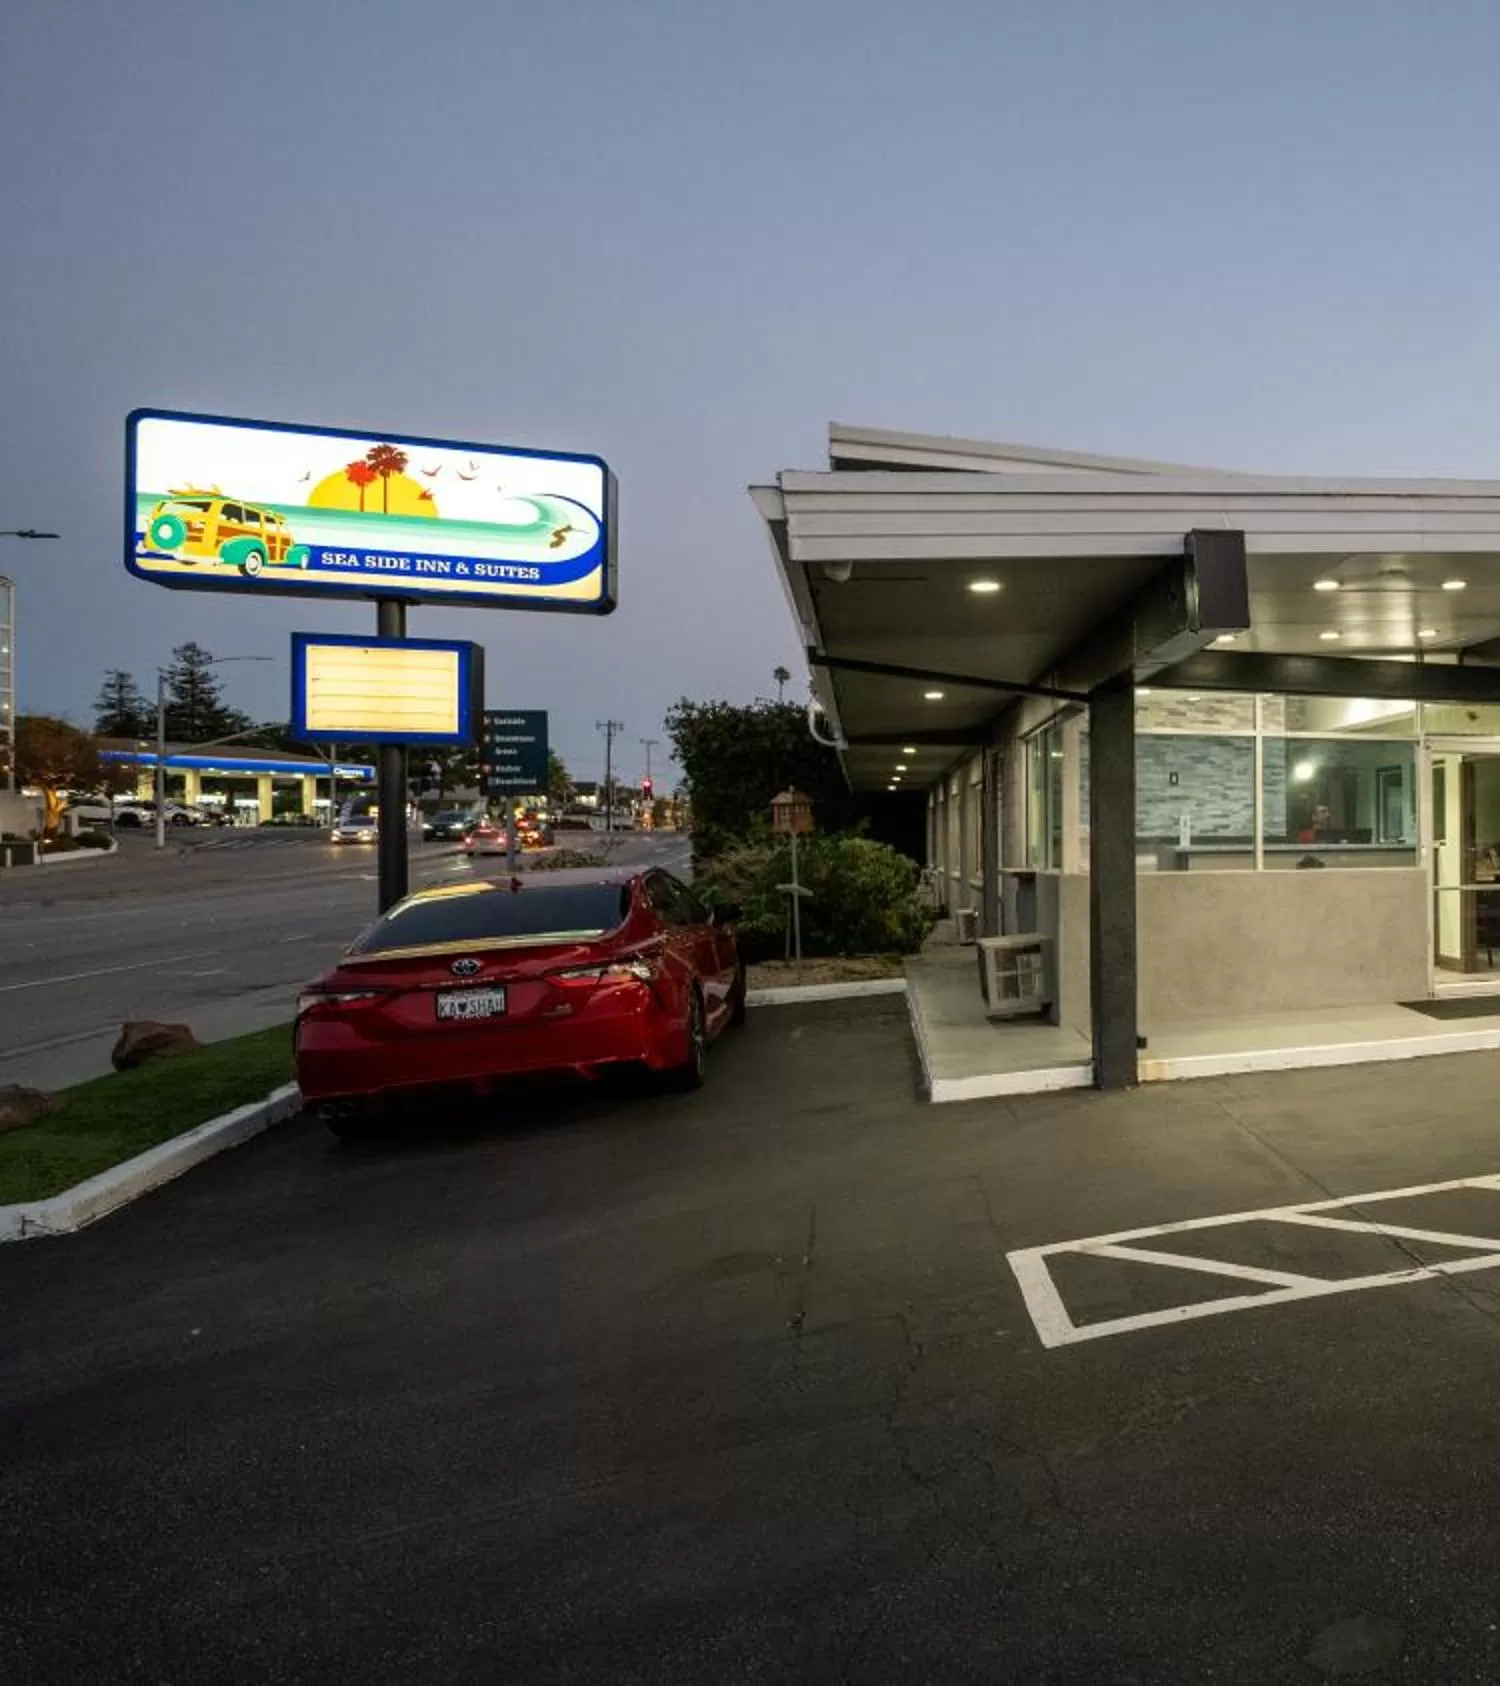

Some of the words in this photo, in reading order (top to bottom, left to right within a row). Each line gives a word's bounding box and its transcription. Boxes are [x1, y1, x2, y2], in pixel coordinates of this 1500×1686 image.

[321, 551, 359, 567] SEA
[365, 554, 411, 571] SIDE
[415, 558, 451, 573] INN
[455, 561, 470, 575] &
[474, 563, 540, 580] SUITES
